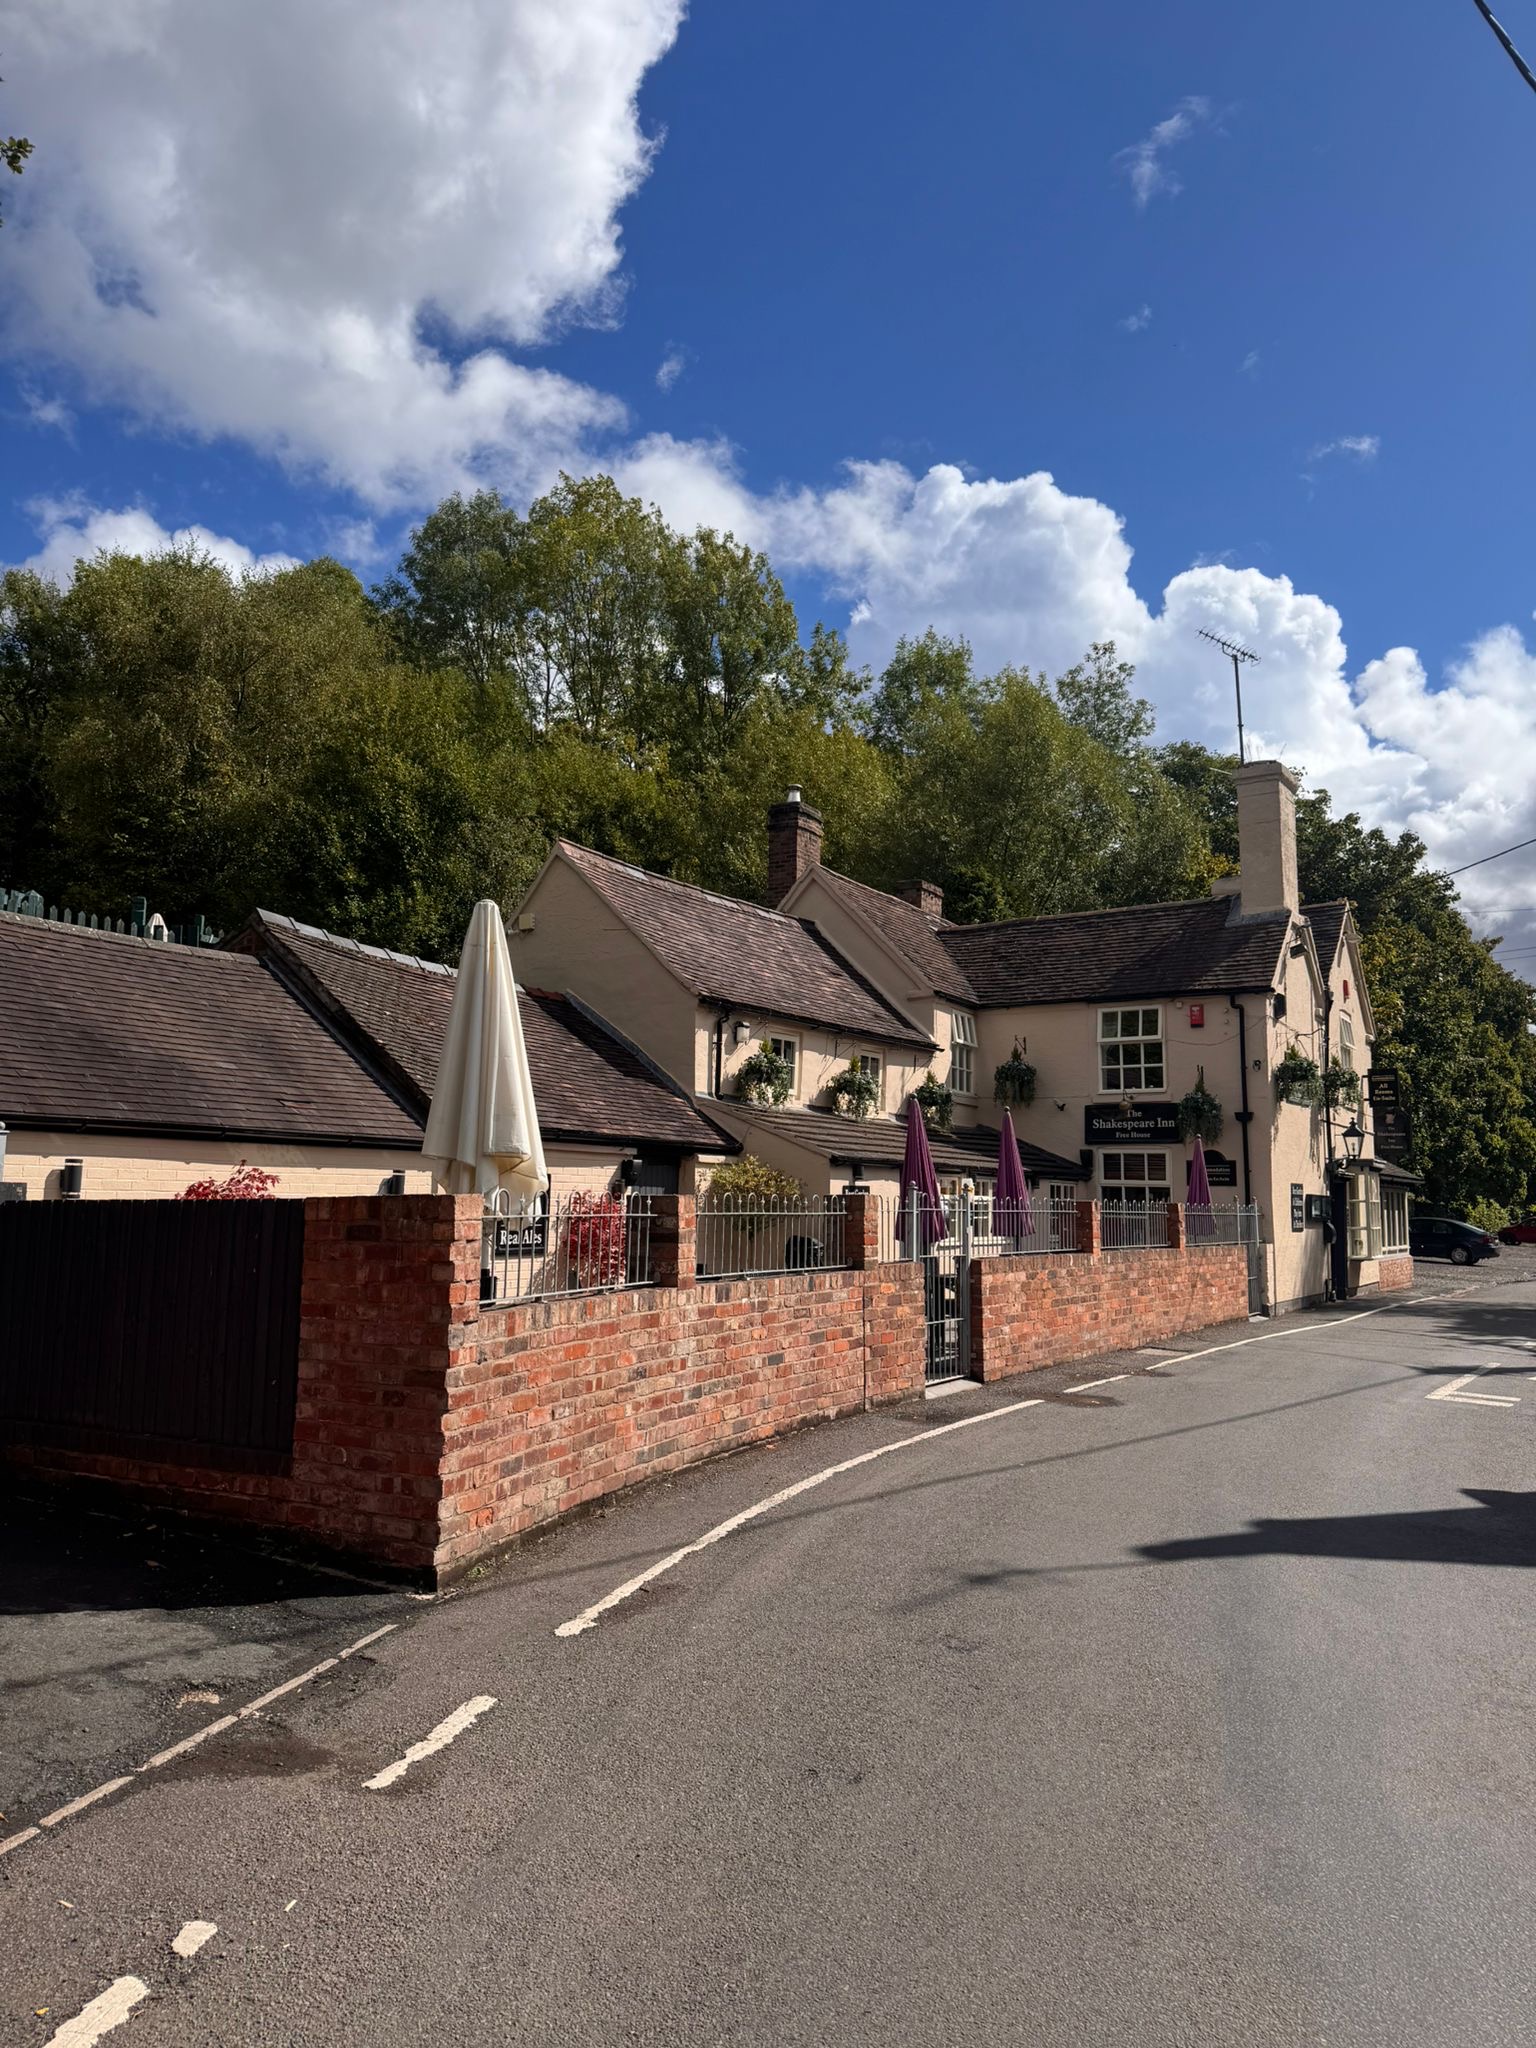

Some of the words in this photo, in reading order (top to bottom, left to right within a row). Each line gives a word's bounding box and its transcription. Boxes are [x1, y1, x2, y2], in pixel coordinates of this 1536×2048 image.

[1127, 1110, 1142, 1118] The
[1092, 1118, 1155, 1130] Shakespeare
[1156, 1117, 1175, 1128] Inn
[522, 1229, 542, 1244] Ales
